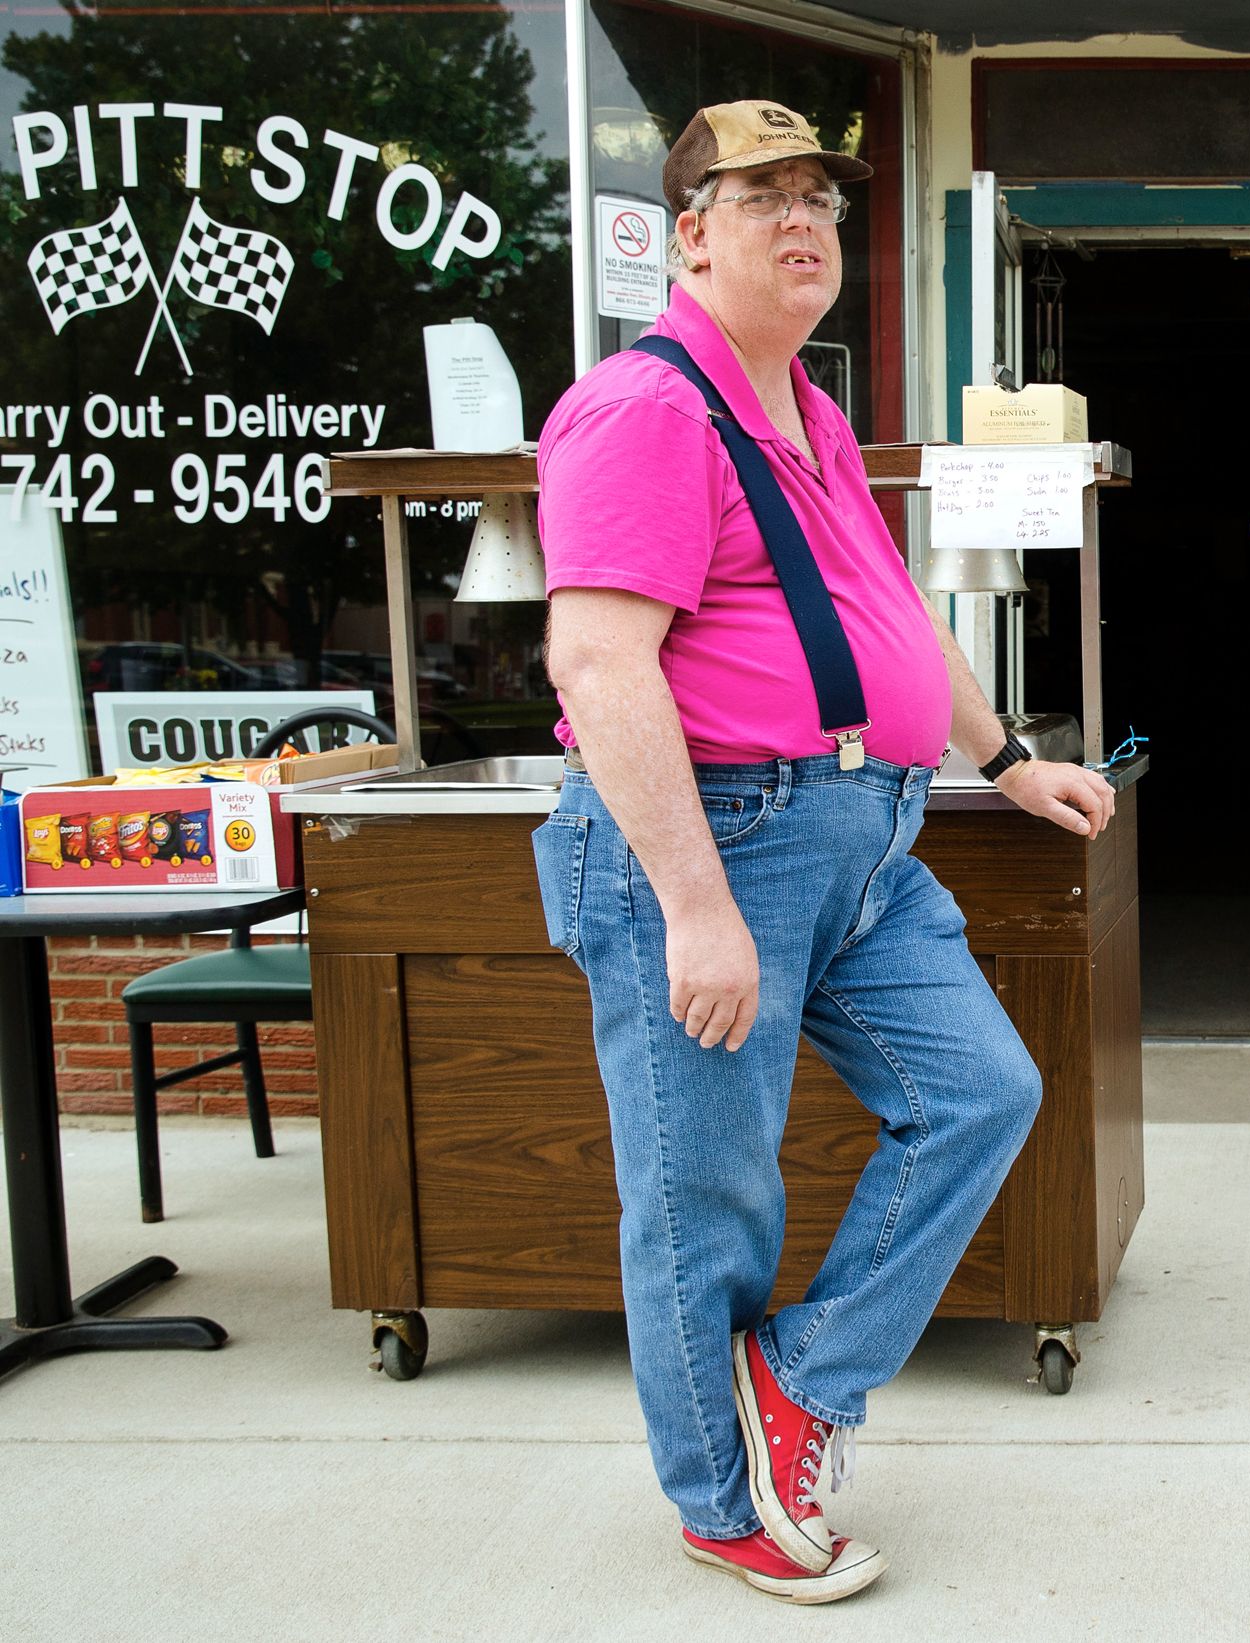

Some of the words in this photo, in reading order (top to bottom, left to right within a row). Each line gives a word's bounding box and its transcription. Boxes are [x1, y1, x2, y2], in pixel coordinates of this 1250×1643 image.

[758, 133, 787, 144] JOHN
[12, 102, 223, 199] PITT
[250, 115, 501, 271] STOP
[605, 257, 617, 268] NO
[619, 259, 658, 274] SMOKING
[0, 405, 70, 448] arry
[84, 394, 164, 438] Out
[205, 395, 385, 446] Delivery
[1027, 473, 1050, 484] Chips
[1, 453, 117, 523] 742
[171, 452, 331, 523] 9546
[1022, 508, 1044, 517] Sweet
[219, 793, 255, 805] Variety
[229, 803, 247, 813] Mix
[60, 826, 82, 834] Doritos
[179, 822, 202, 830] Doritos
[232, 827, 250, 840] 30
